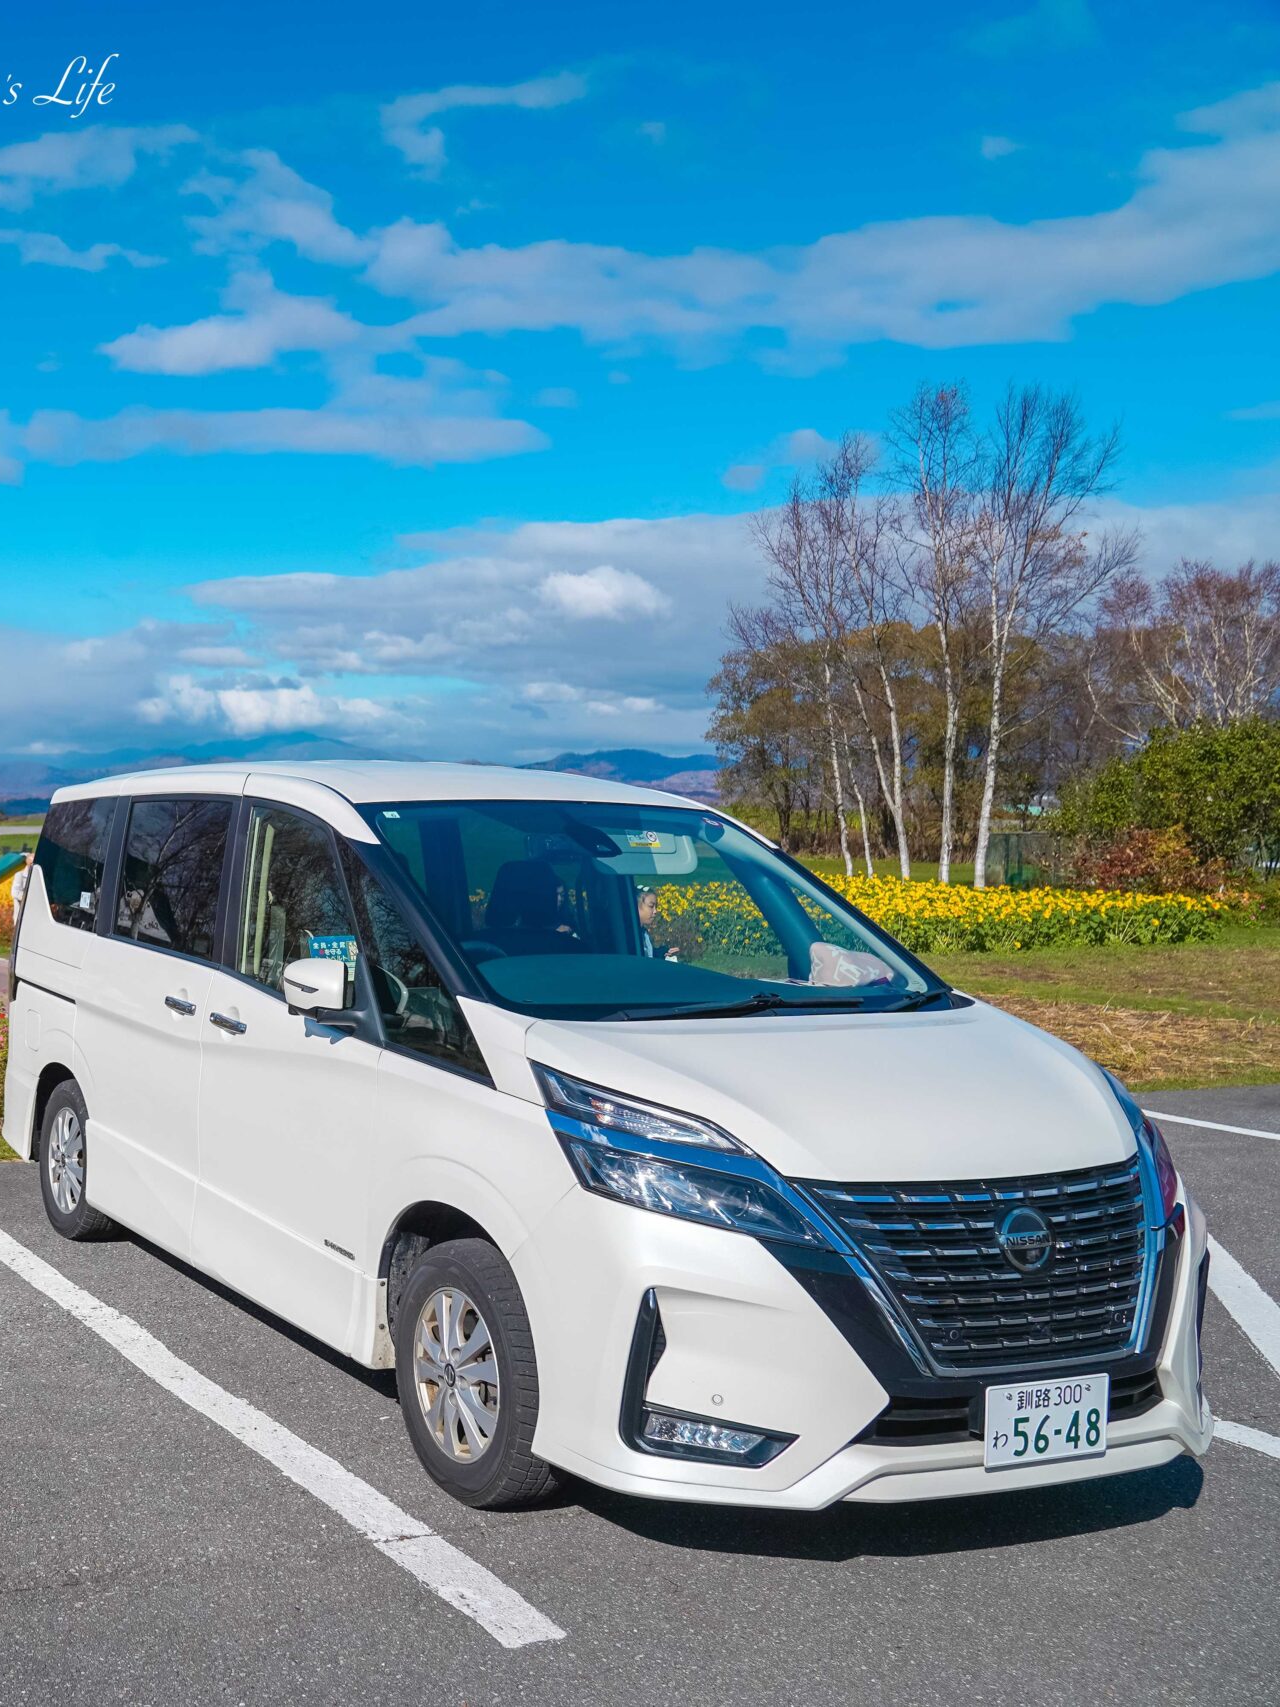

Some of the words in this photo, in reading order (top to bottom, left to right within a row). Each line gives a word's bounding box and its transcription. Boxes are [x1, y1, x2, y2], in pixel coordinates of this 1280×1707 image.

[1005, 1234, 1050, 1246] NISSAN
[992, 1430, 1009, 1450] わ
[1013, 1407, 1101, 1457] 56-48
